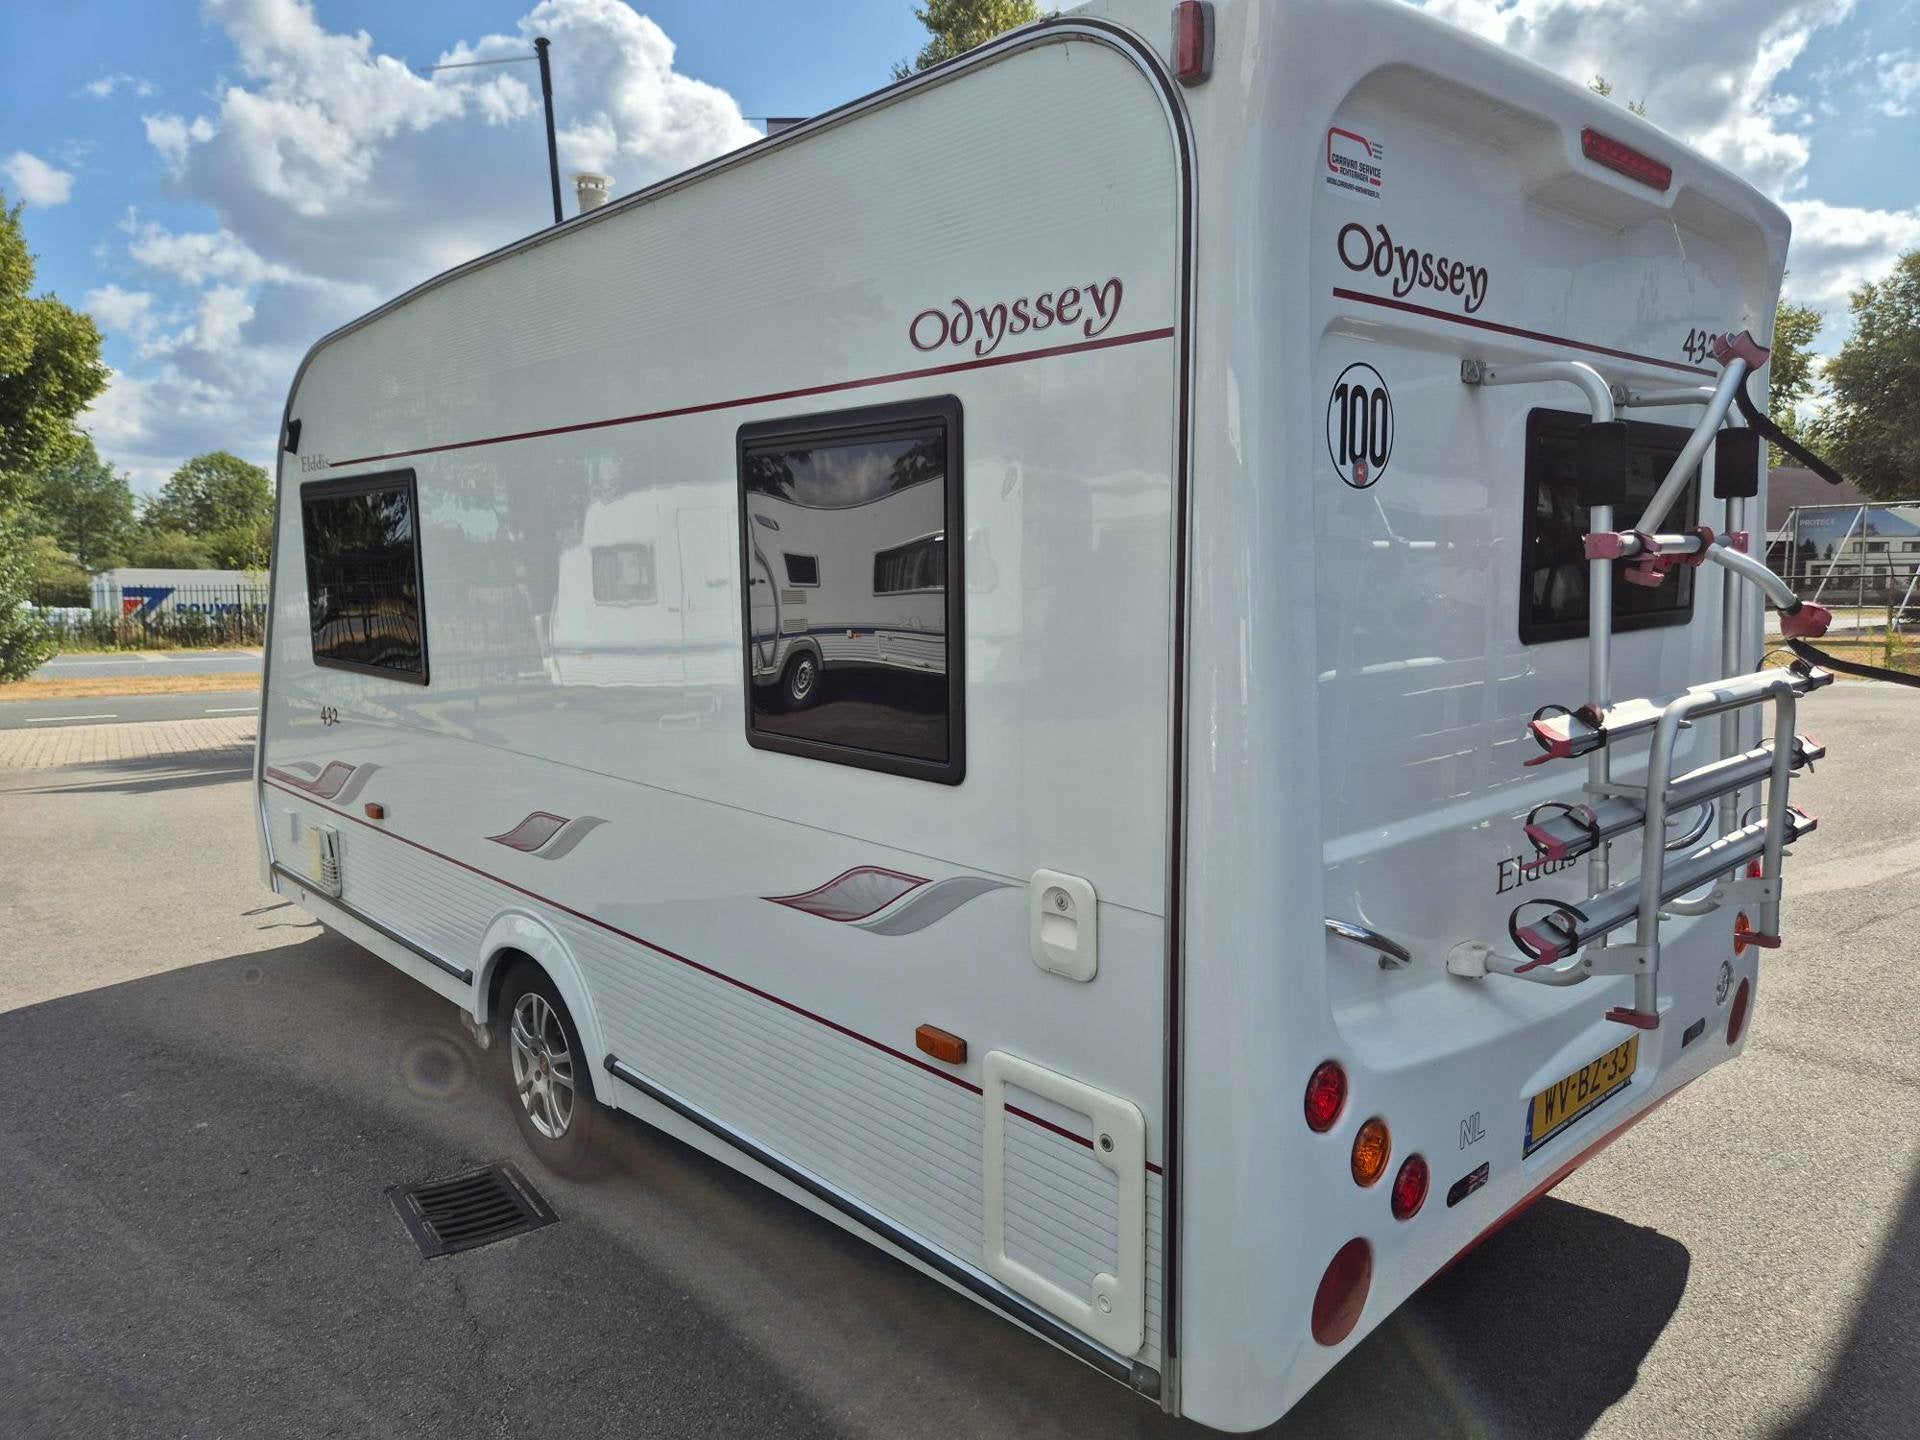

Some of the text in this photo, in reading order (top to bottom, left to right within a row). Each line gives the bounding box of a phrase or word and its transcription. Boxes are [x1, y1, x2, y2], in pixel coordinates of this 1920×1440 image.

[1359, 162, 1381, 178] SERVICE
[1337, 222, 1488, 314] Odyssey
[909, 276, 1124, 358] Odyssey
[1334, 383, 1388, 469] 100
[320, 705, 341, 727] 432
[1544, 1039, 1630, 1126] WV-BZ-33
[1459, 1111, 1486, 1151] NL
